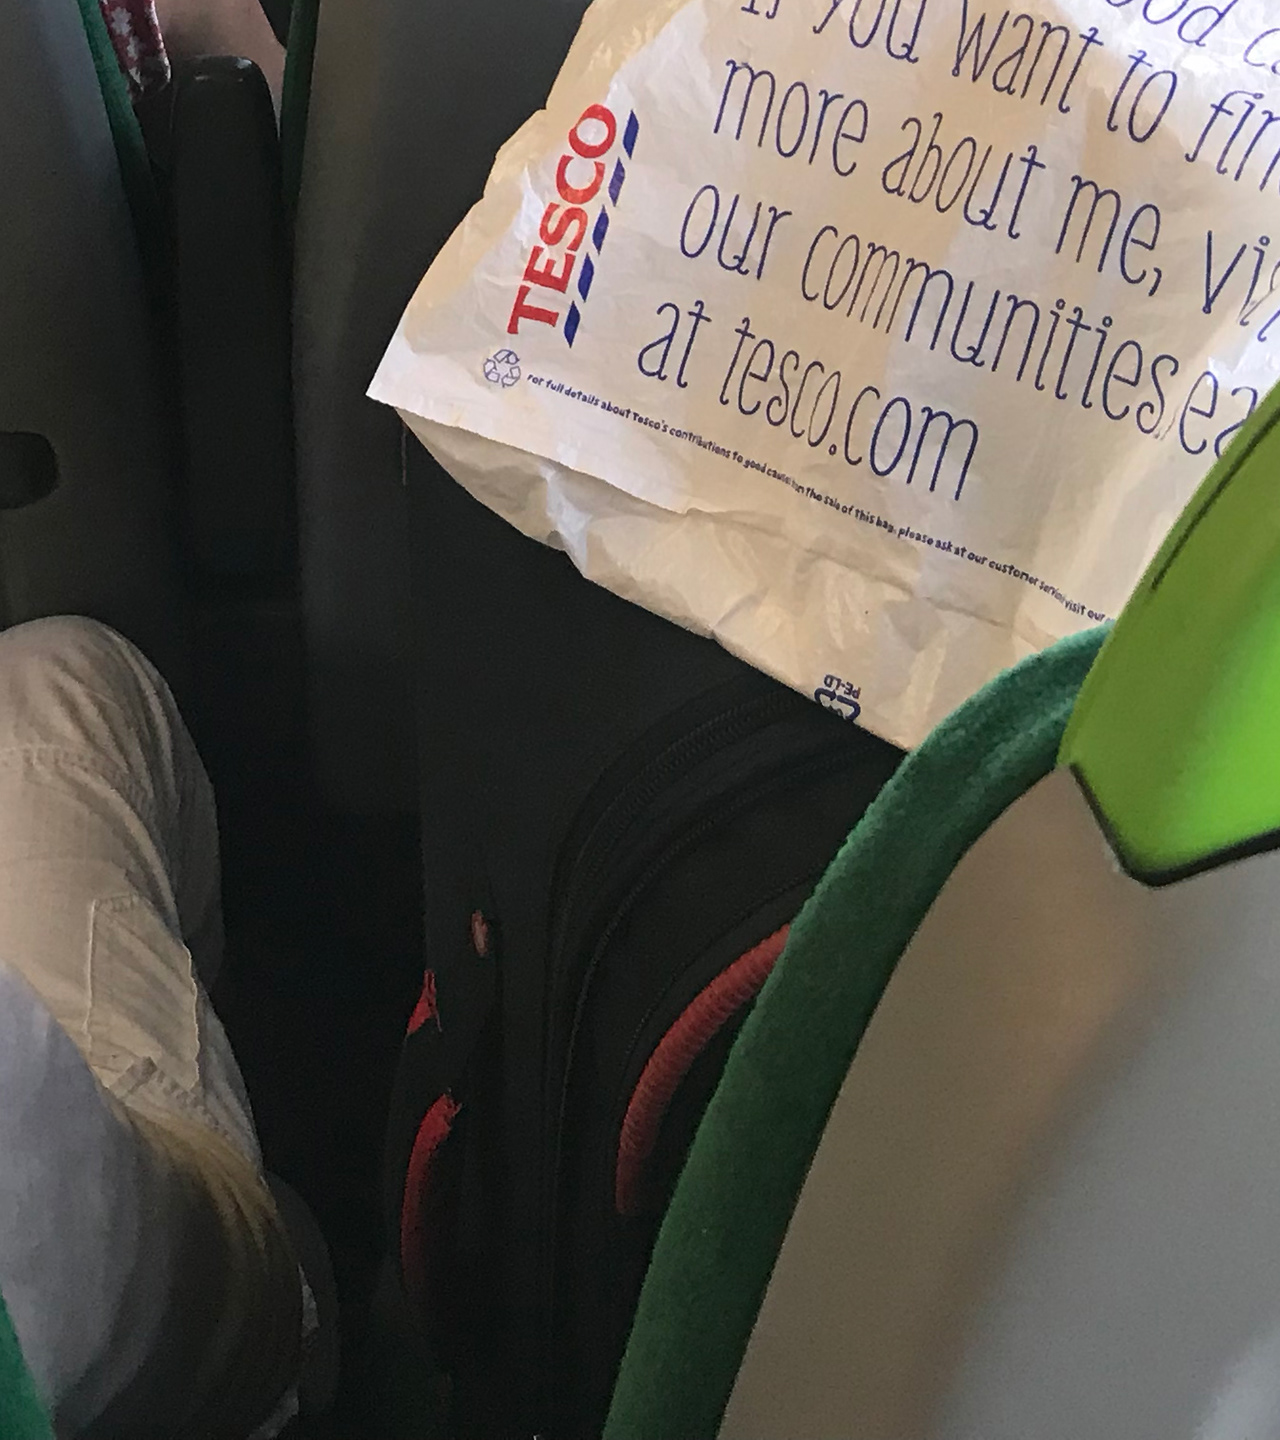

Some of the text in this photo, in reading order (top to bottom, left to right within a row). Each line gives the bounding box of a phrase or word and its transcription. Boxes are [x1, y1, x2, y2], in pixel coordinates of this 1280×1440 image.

[713, 59, 869, 177] more
[881, 112, 1047, 240] about
[1055, 174, 1163, 297] me,
[1106, 50, 1178, 143] to
[507, 103, 618, 335] TESCO
[679, 184, 793, 280] our
[801, 225, 1179, 434] communities
[545, 379, 565, 394] full
[564, 387, 600, 407] details
[600, 401, 632, 419] about
[632, 412, 669, 434] Tesco's
[669, 427, 732, 459] contributions
[732, 451, 744, 464] to
[743, 459, 767, 474] good
[805, 487, 823, 502] the
[823, 495, 841, 511] sale
[841, 505, 855, 517] of
[855, 509, 876, 525] this
[897, 526, 934, 546] please
[935, 539, 953, 553] ask
[954, 546, 967, 559] at
[967, 551, 988, 566] our
[988, 559, 1039, 587] customer
[1064, 600, 1086, 616] visit
[1087, 609, 1106, 622] our
[637, 300, 979, 501] at tesco.com
